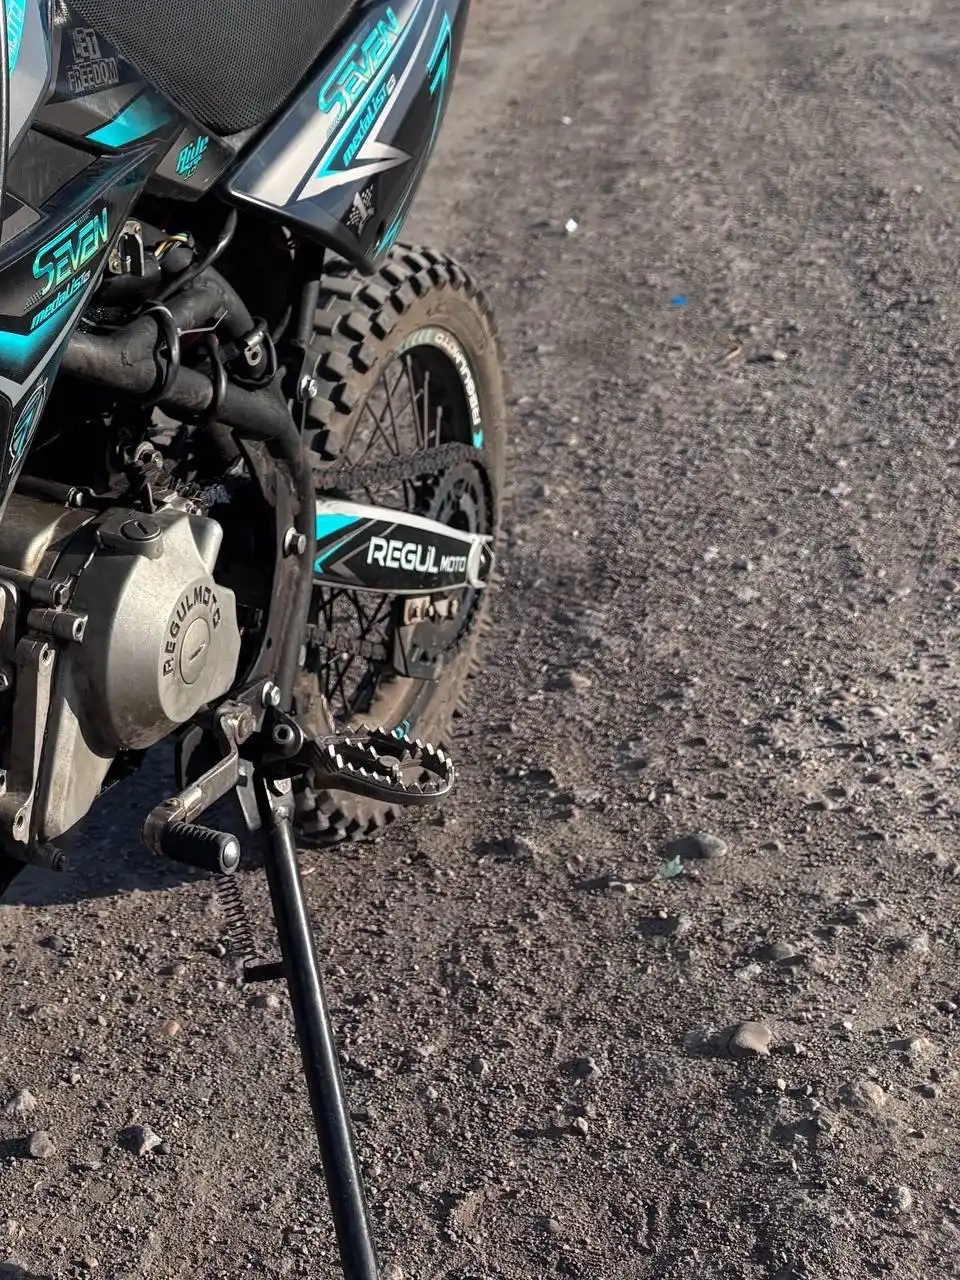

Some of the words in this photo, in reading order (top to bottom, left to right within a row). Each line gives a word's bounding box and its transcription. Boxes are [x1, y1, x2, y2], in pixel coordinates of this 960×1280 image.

[32, 207, 109, 296] SEVEN
[366, 536, 439, 574] REGUL
[440, 554, 467, 573] MOTO
[162, 585, 221, 677] REGULMOTO
